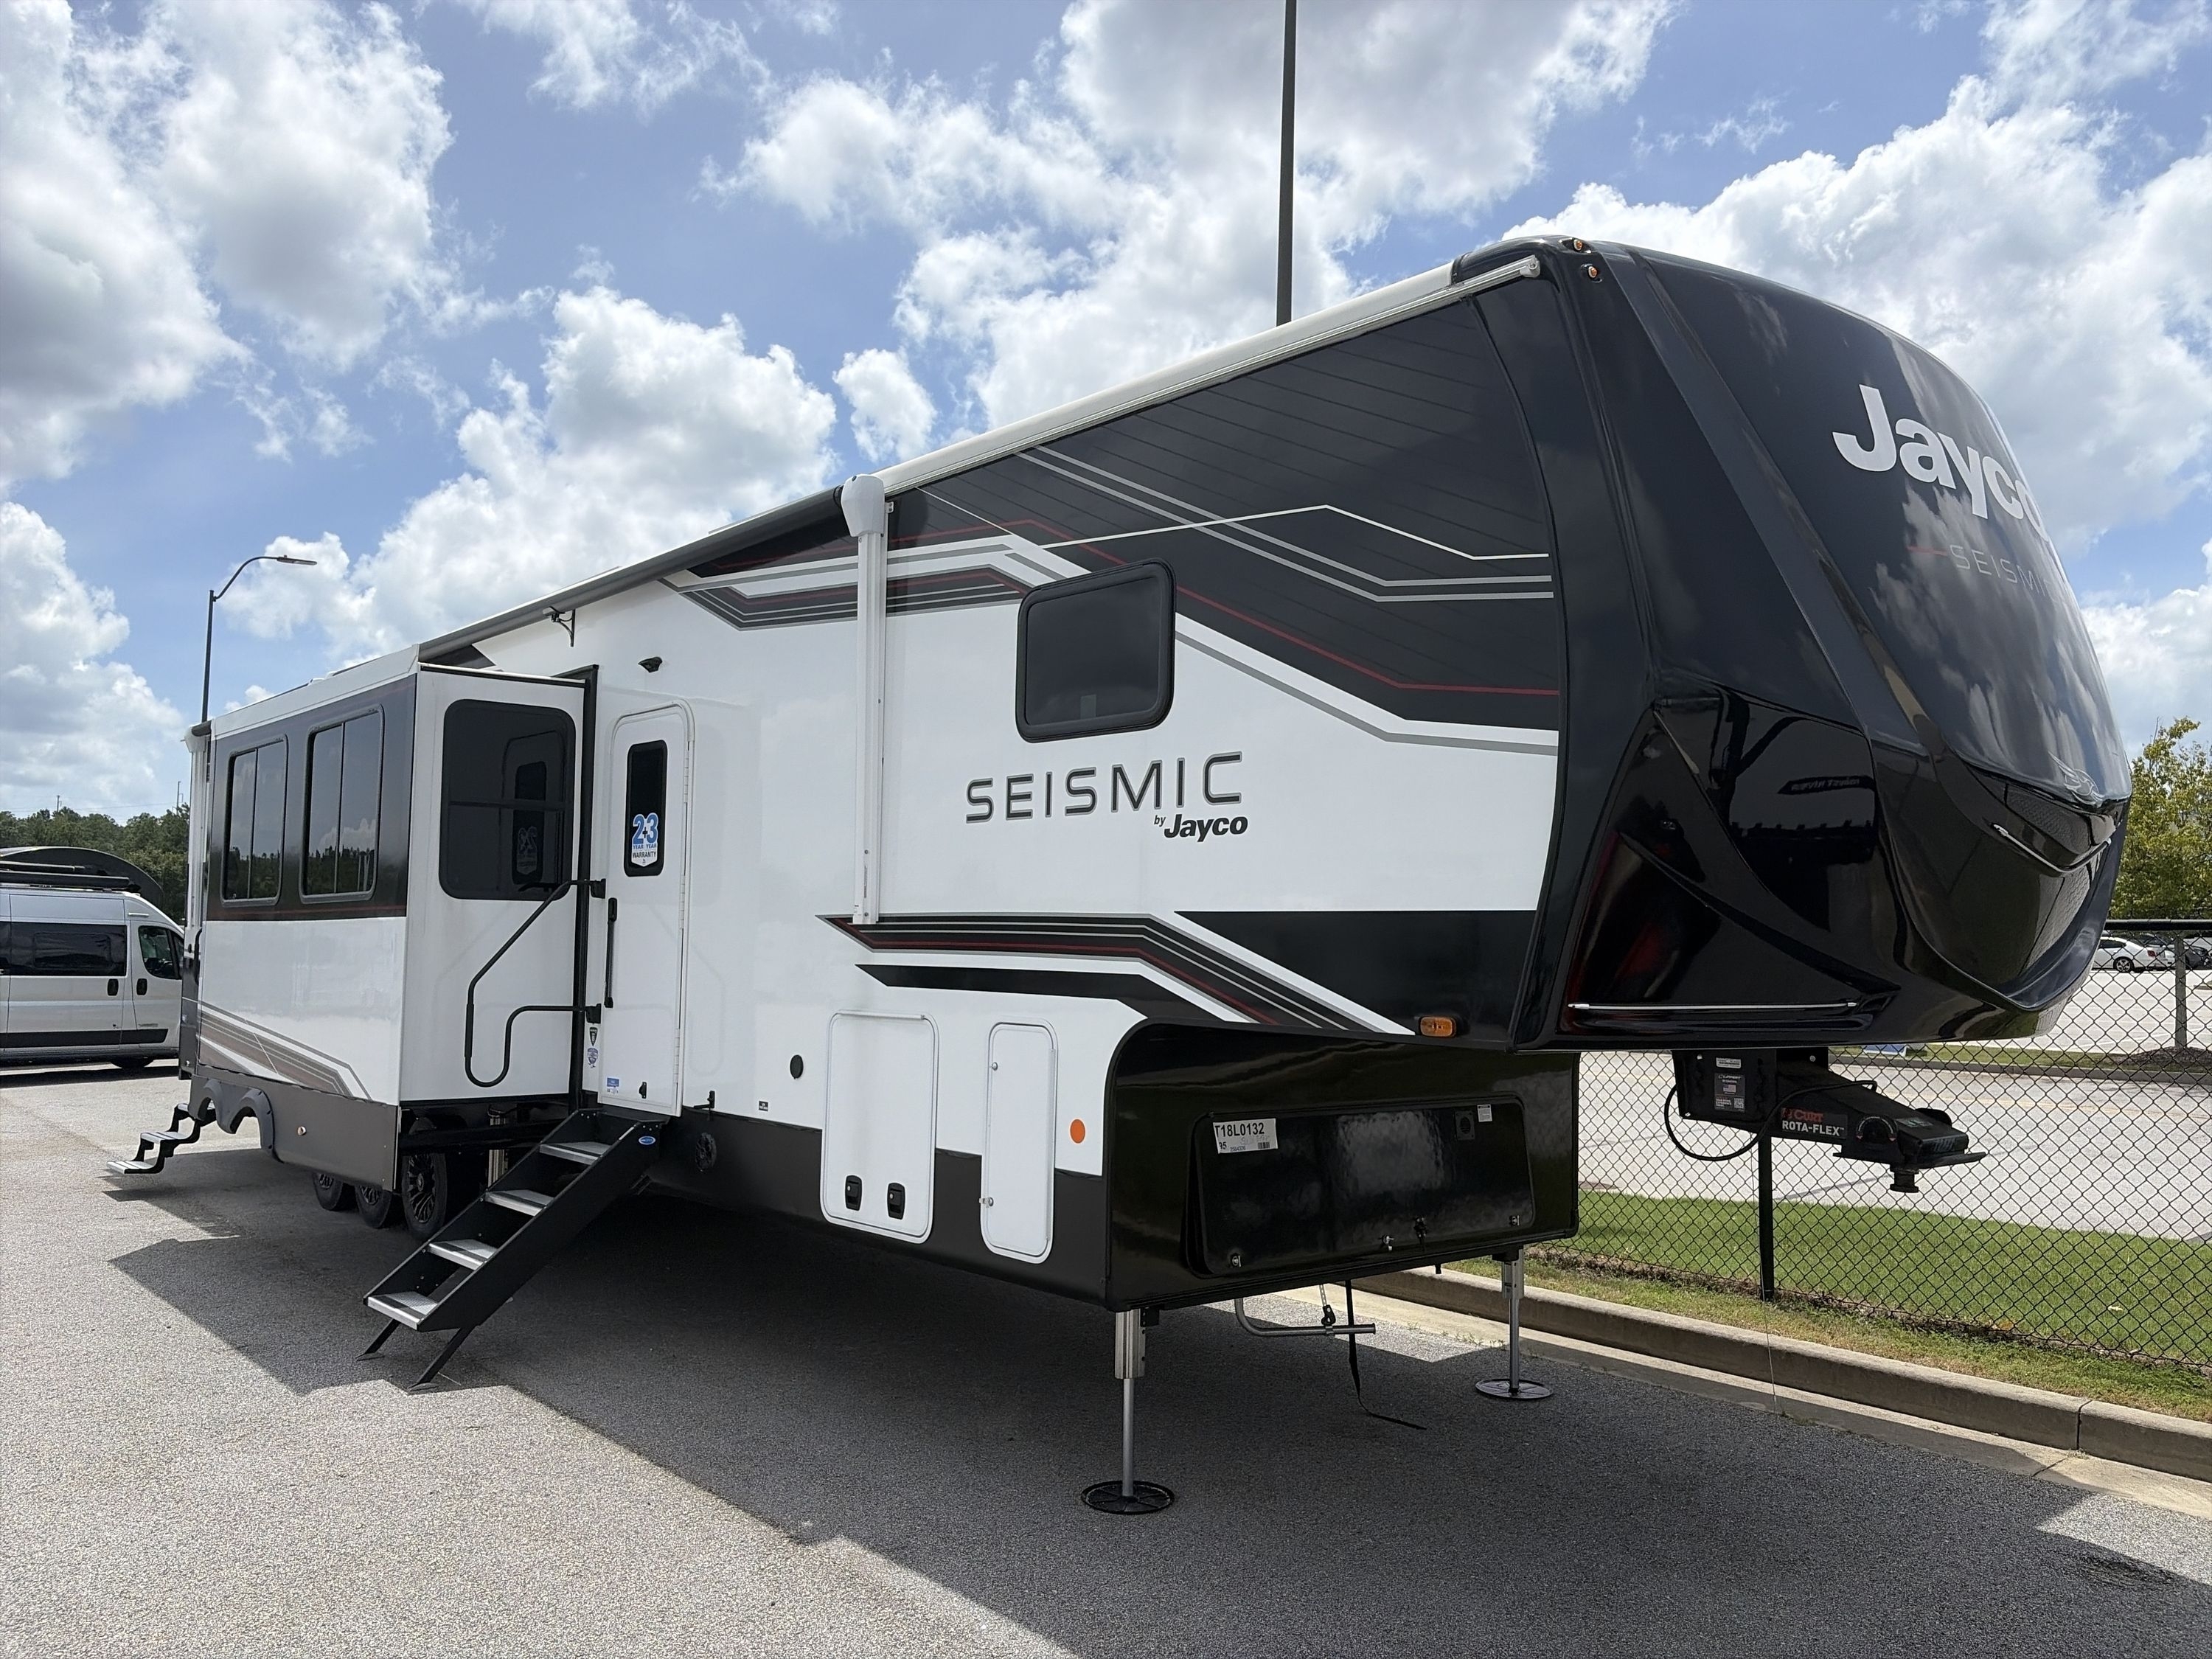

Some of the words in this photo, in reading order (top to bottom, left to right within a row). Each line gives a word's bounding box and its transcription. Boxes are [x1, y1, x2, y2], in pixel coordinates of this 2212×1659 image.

[1832, 384, 2049, 542] Jayco
[966, 751, 1242, 824] SEISMIC
[1154, 814, 1166, 827] by
[1164, 813, 1248, 842] Jayco
[1214, 1122, 1265, 1138] T18L0132
